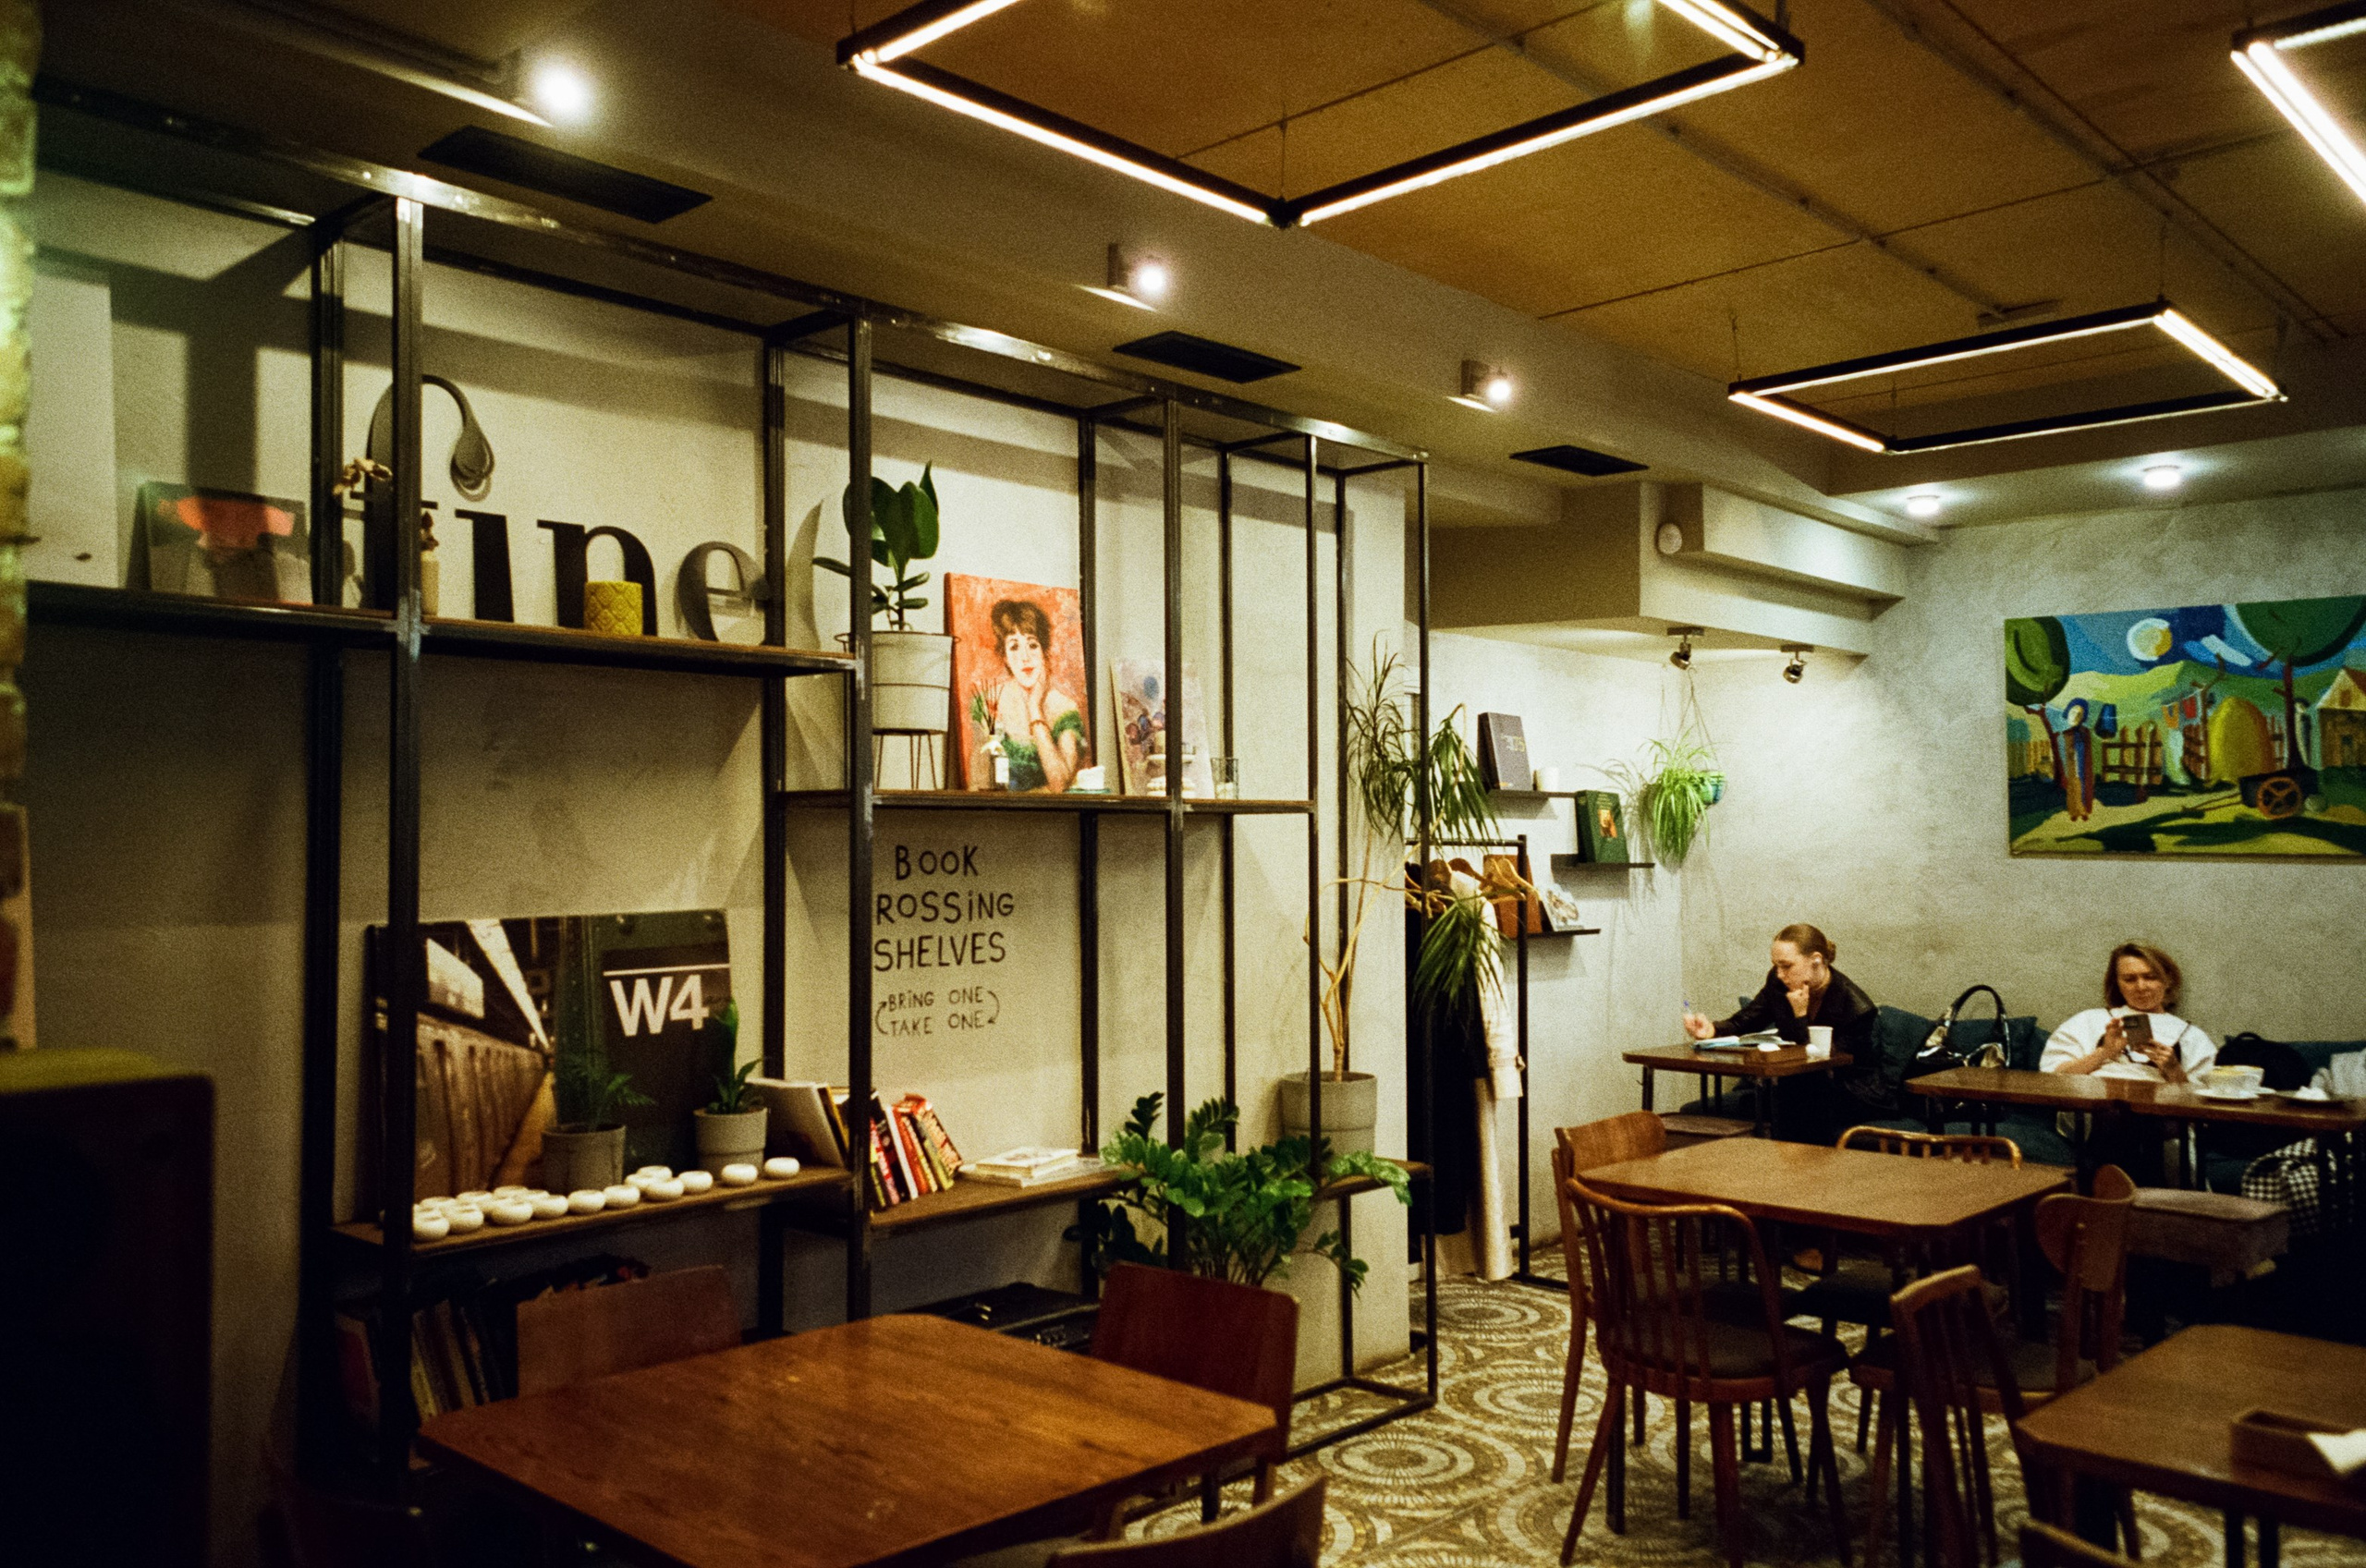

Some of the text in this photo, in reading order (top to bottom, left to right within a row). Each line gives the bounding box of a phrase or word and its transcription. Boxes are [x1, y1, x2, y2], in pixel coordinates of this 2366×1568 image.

[896, 845, 978, 881] BOOK
[873, 930, 1006, 972] SHELVES
[609, 974, 710, 1037] W4
[948, 986, 983, 1004] ONE
[890, 1010, 984, 1036] TAKE ONE
